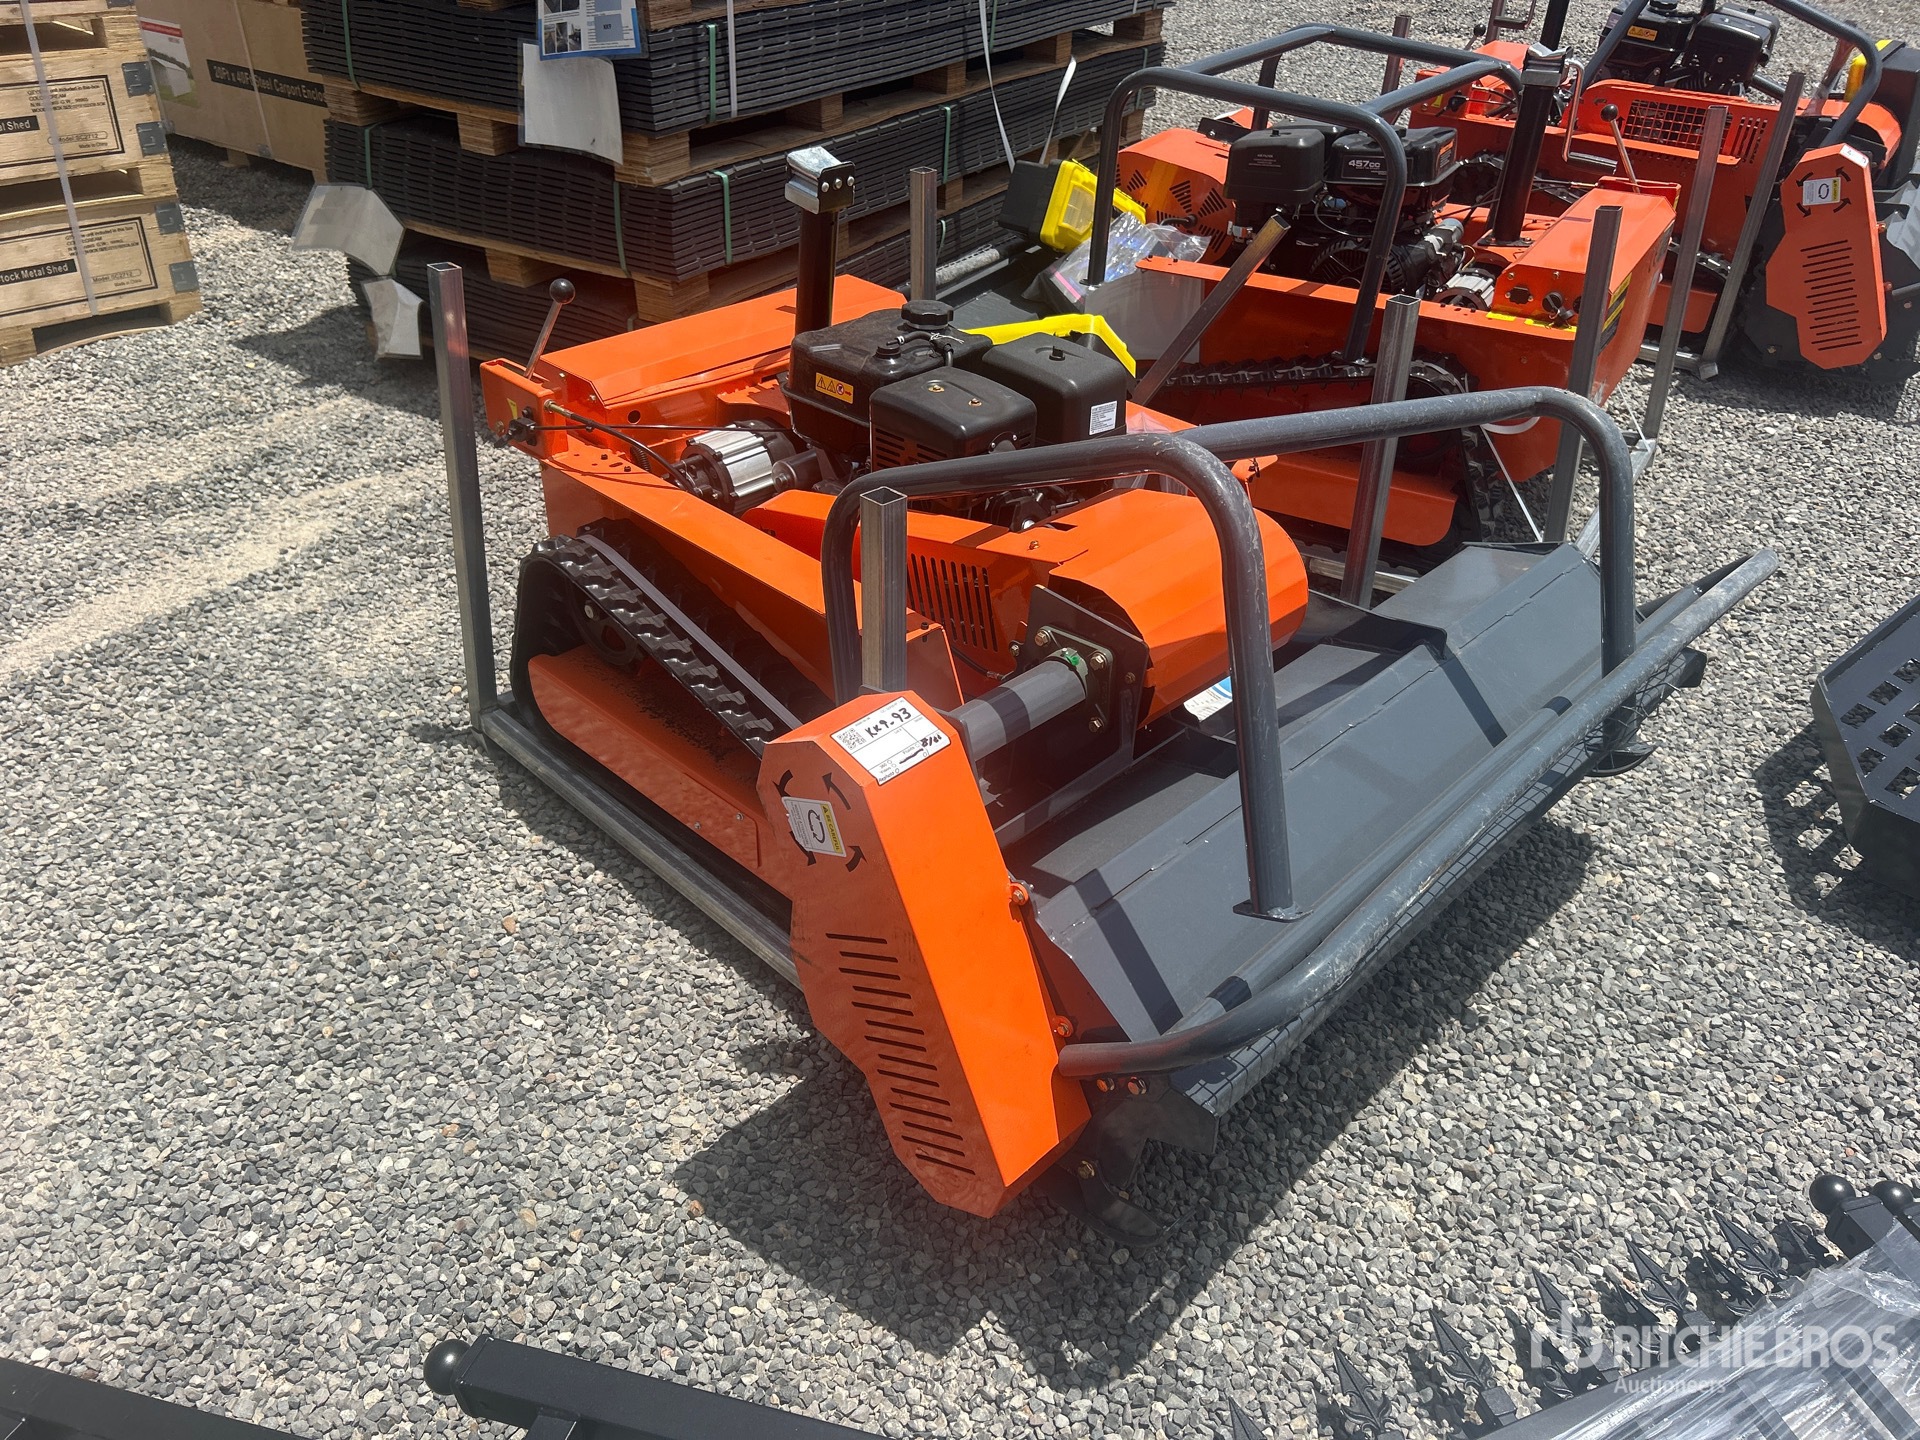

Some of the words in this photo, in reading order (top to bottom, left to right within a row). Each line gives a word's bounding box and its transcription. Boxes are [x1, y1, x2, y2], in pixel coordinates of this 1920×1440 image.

[273, 78, 302, 98] Carport
[7, 120, 31, 131] Shed
[21, 268, 45, 278] Metal
[46, 263, 69, 274] Shed
[829, 824, 840, 850] CAREFUL
